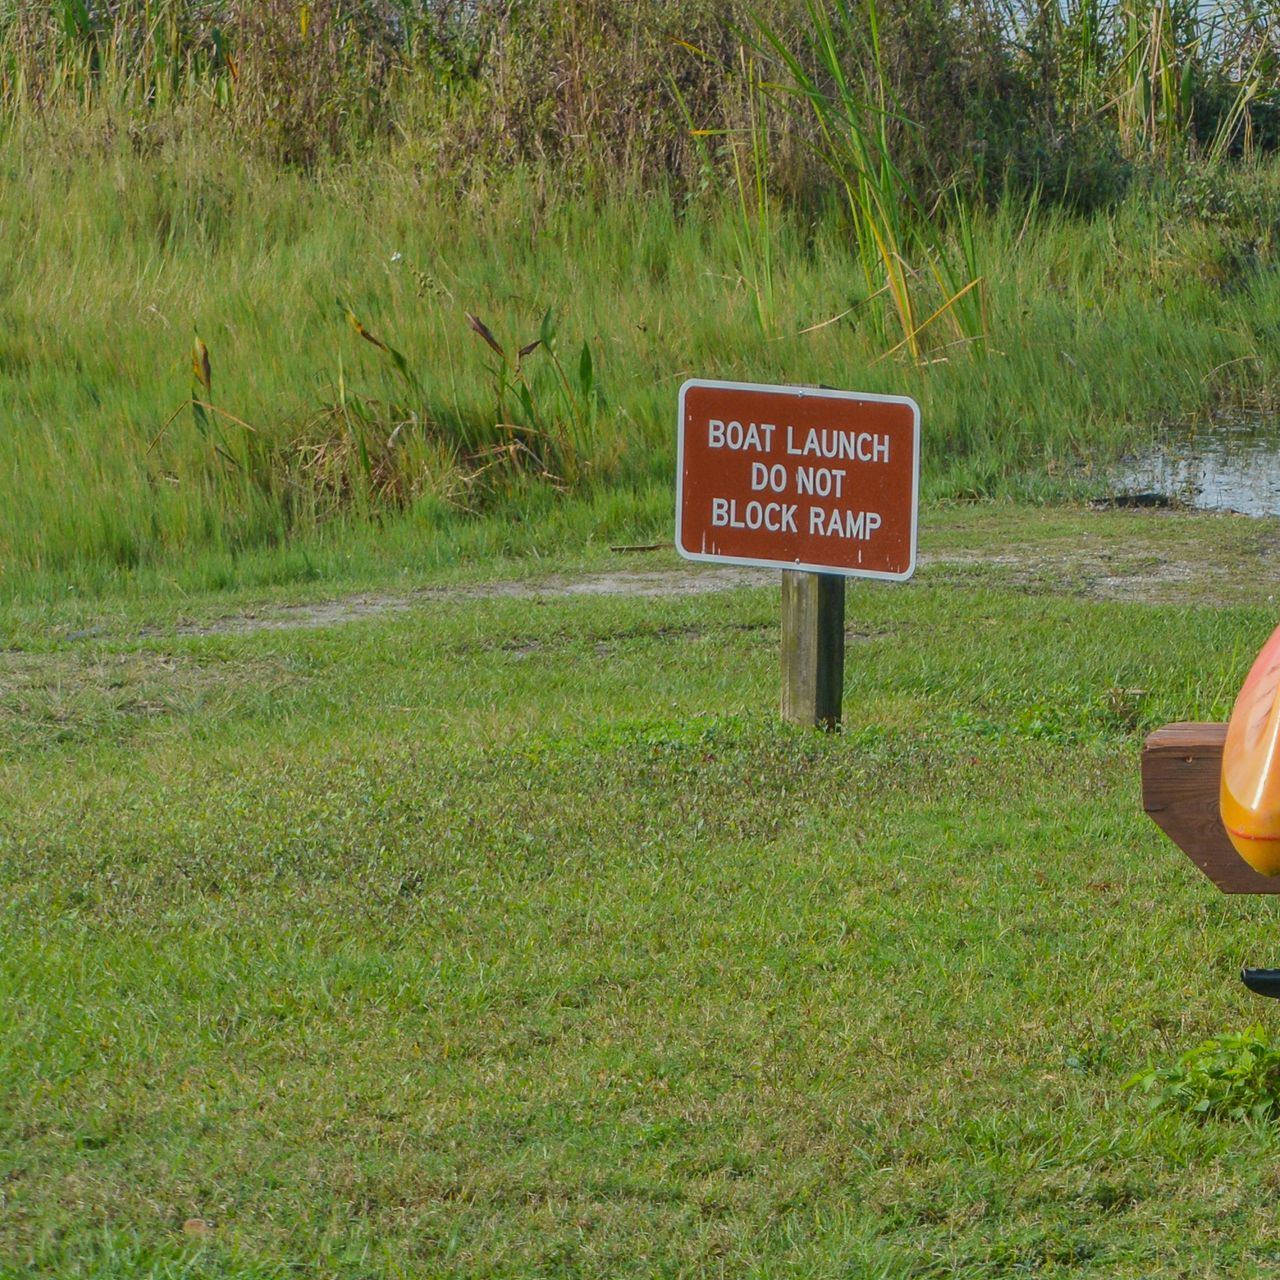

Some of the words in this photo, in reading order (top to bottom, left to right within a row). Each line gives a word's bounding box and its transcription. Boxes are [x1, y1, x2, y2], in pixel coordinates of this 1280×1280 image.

[708, 419, 776, 452] BOAT
[786, 425, 890, 463] LAUNCH
[751, 462, 787, 492] DO
[797, 466, 846, 498] NOT
[711, 497, 799, 533] BLOCK
[809, 506, 882, 541] RAMP
